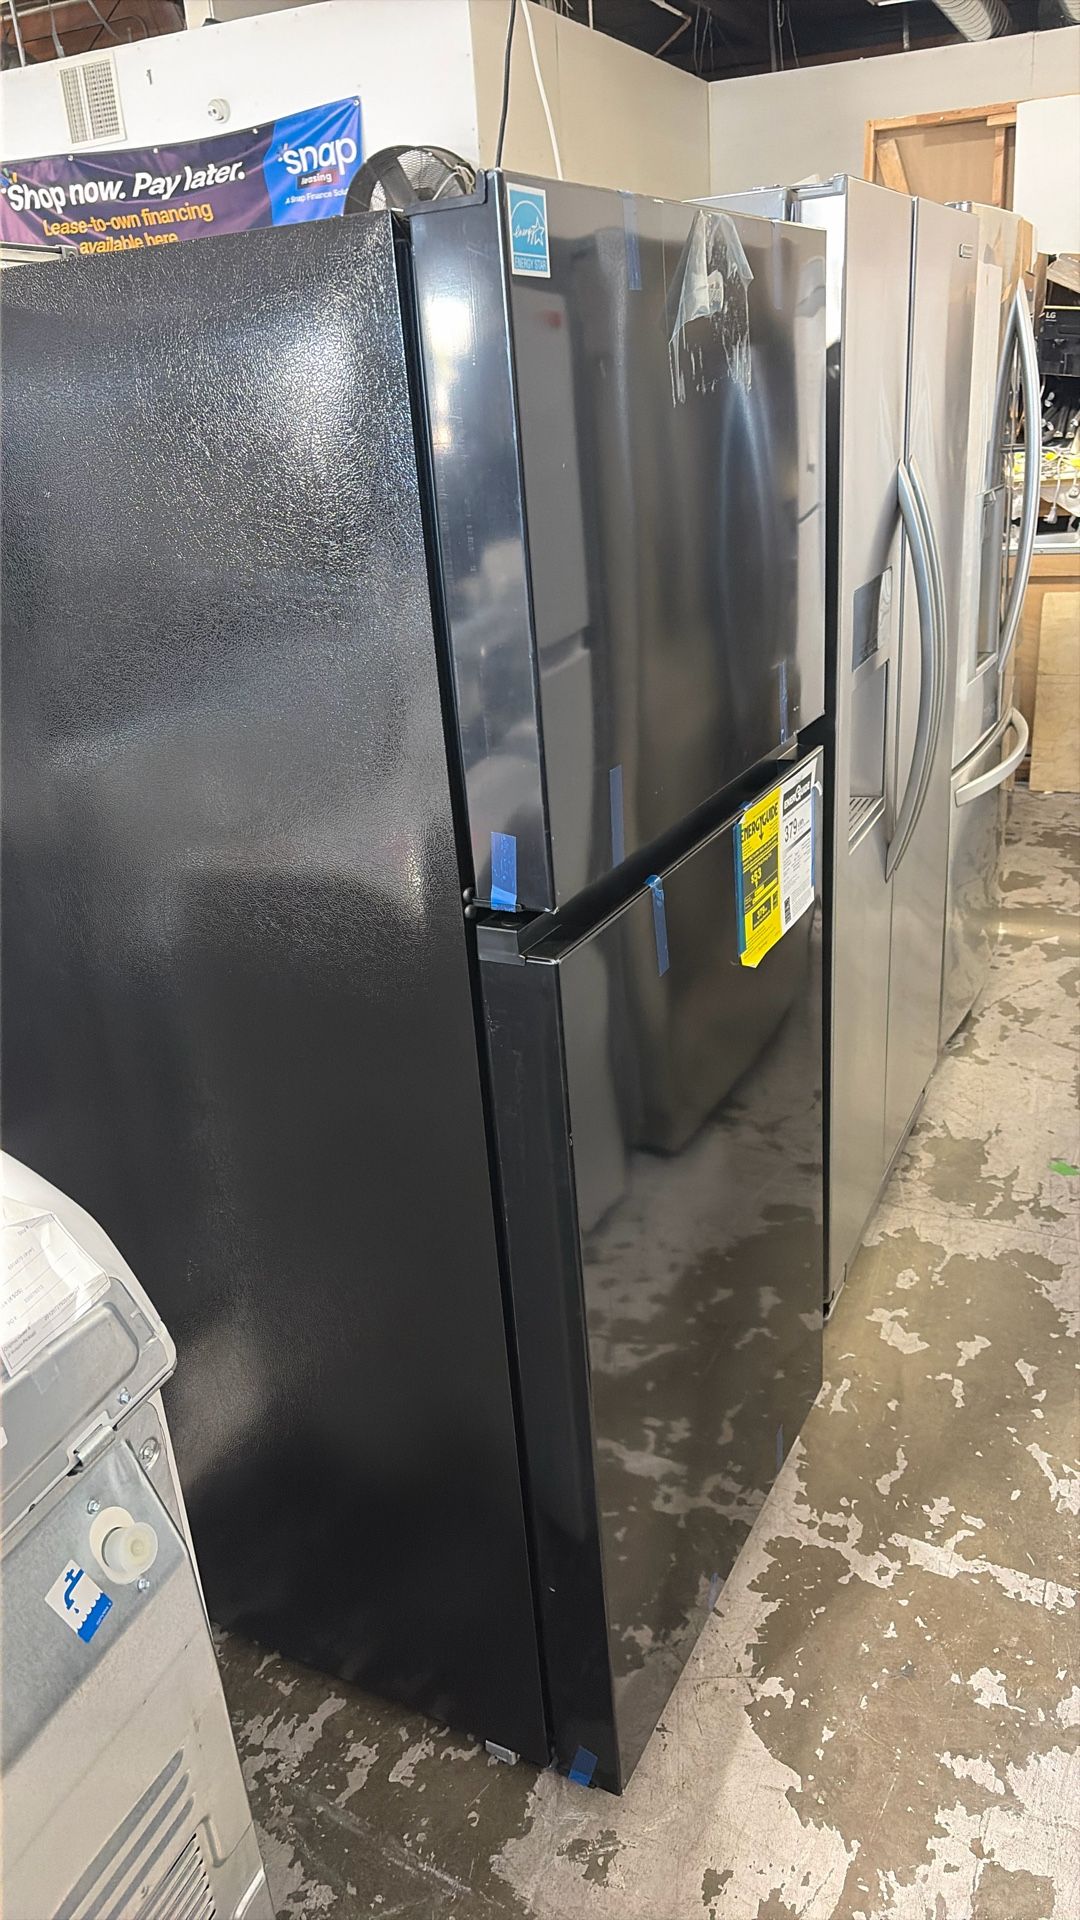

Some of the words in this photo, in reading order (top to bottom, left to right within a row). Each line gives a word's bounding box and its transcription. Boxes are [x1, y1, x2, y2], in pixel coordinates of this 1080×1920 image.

[282, 137, 358, 176] snap
[9, 181, 66, 214] Shop
[70, 179, 126, 205] now.
[132, 171, 182, 200] Pay
[184, 161, 246, 190] later.
[300, 172, 333, 185] leasing
[306, 191, 333, 202] Finance
[42, 214, 140, 237] Lease-to-own
[141, 201, 214, 229] financing
[79, 235, 144, 255] available
[145, 232, 178, 247] here
[1045, 311, 1057, 319] LG
[784, 817, 798, 843] 379
